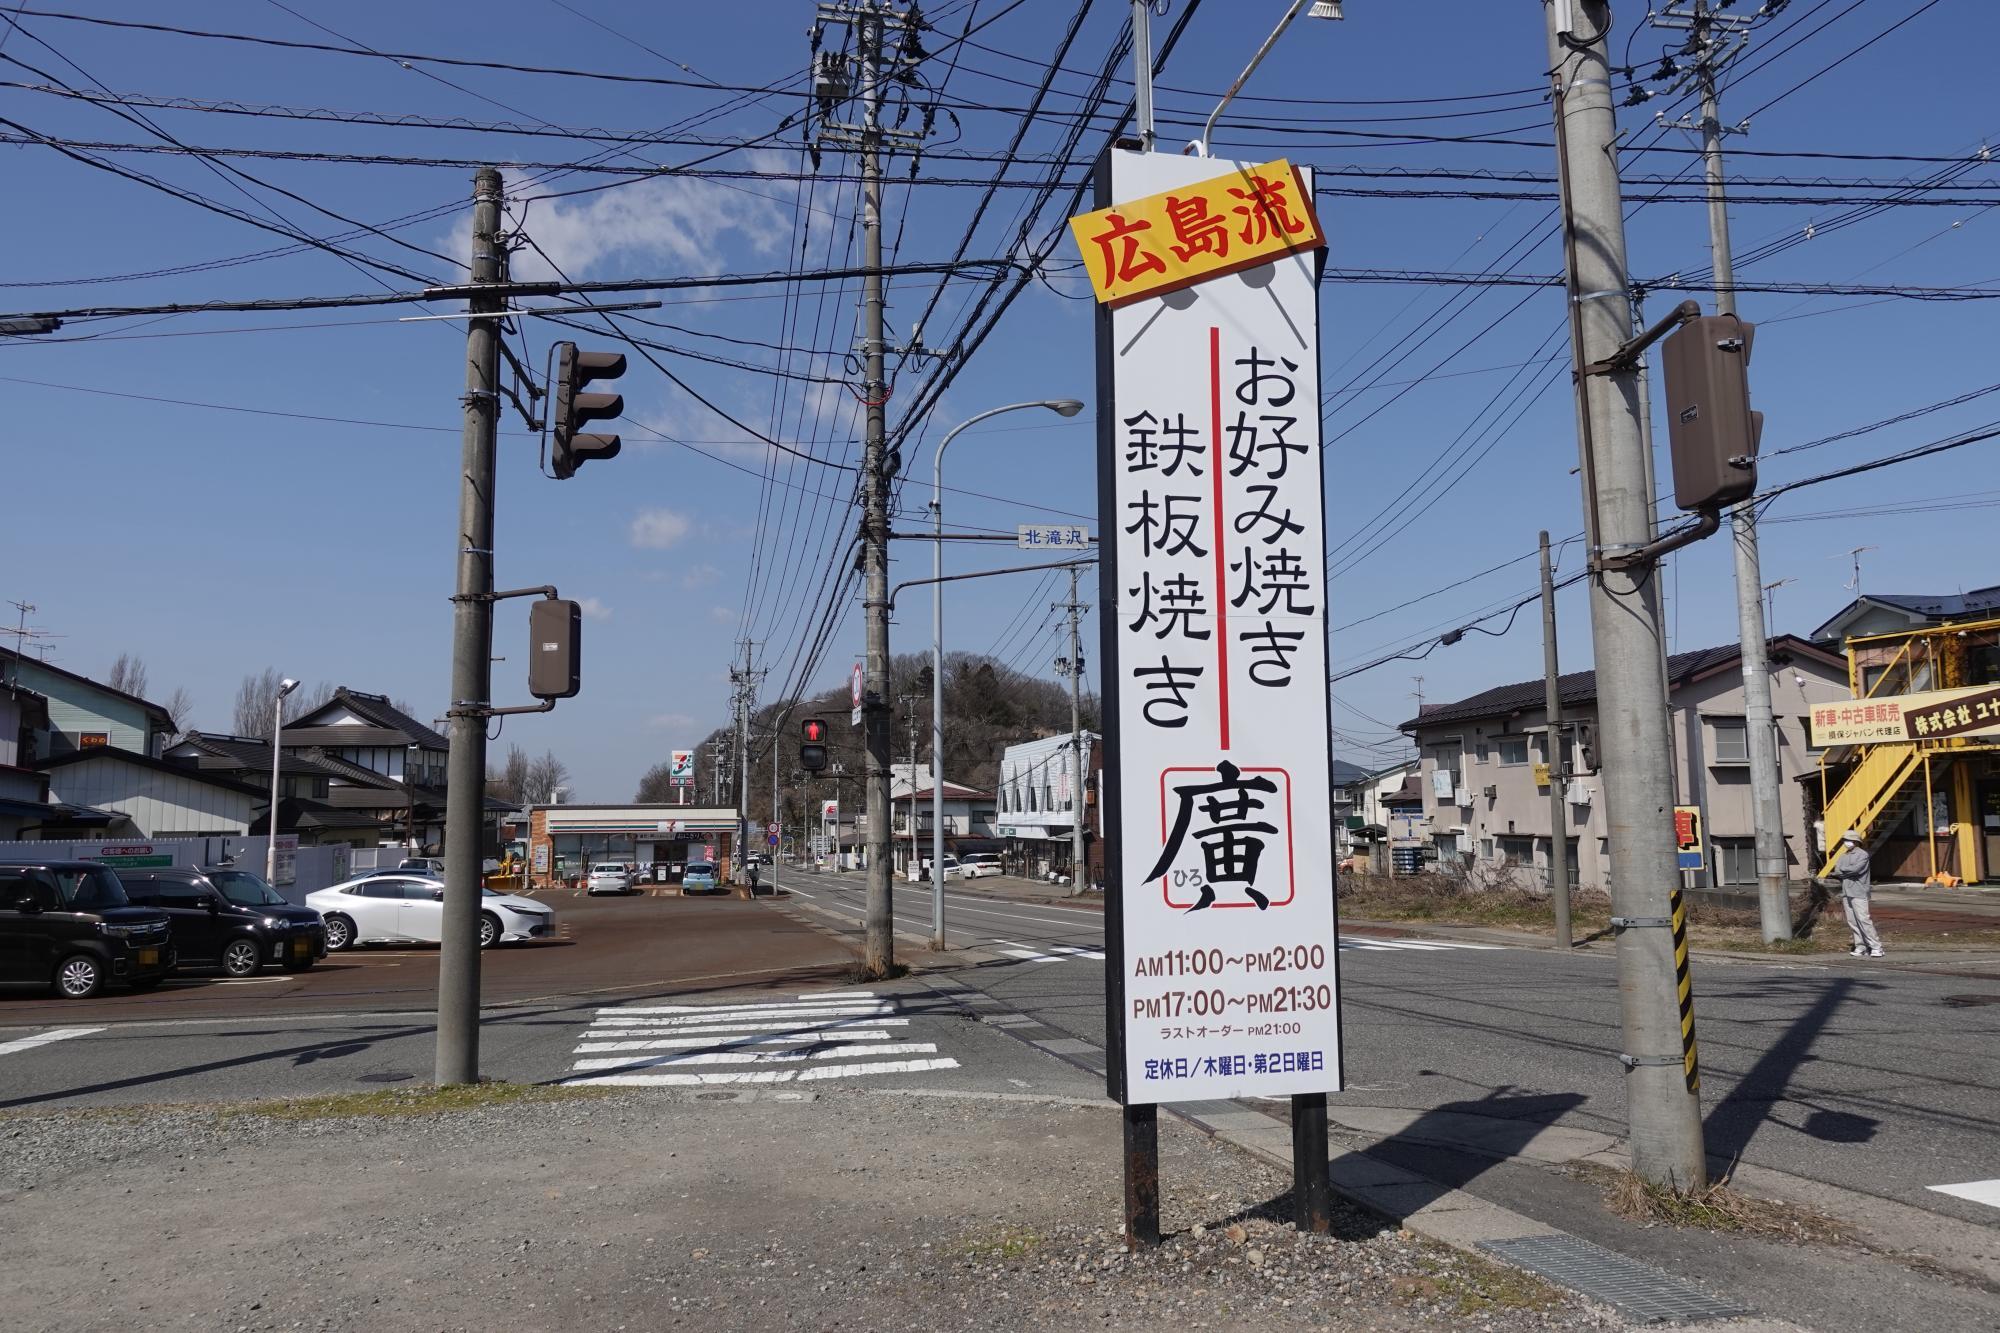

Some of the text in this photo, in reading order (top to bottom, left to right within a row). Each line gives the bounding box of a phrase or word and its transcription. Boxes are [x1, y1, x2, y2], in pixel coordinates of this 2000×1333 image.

[1091, 176, 1305, 290] 広島流
[1025, 529, 1082, 545] 北滝沢
[1123, 409, 1211, 729] 鉄板焼き
[1225, 346, 1314, 688] お好み焼き
[1142, 760, 1279, 914] 廣
[1173, 868, 1203, 888] ひろ
[1160, 1022, 1301, 1040] ラストオーダー PM21:00
